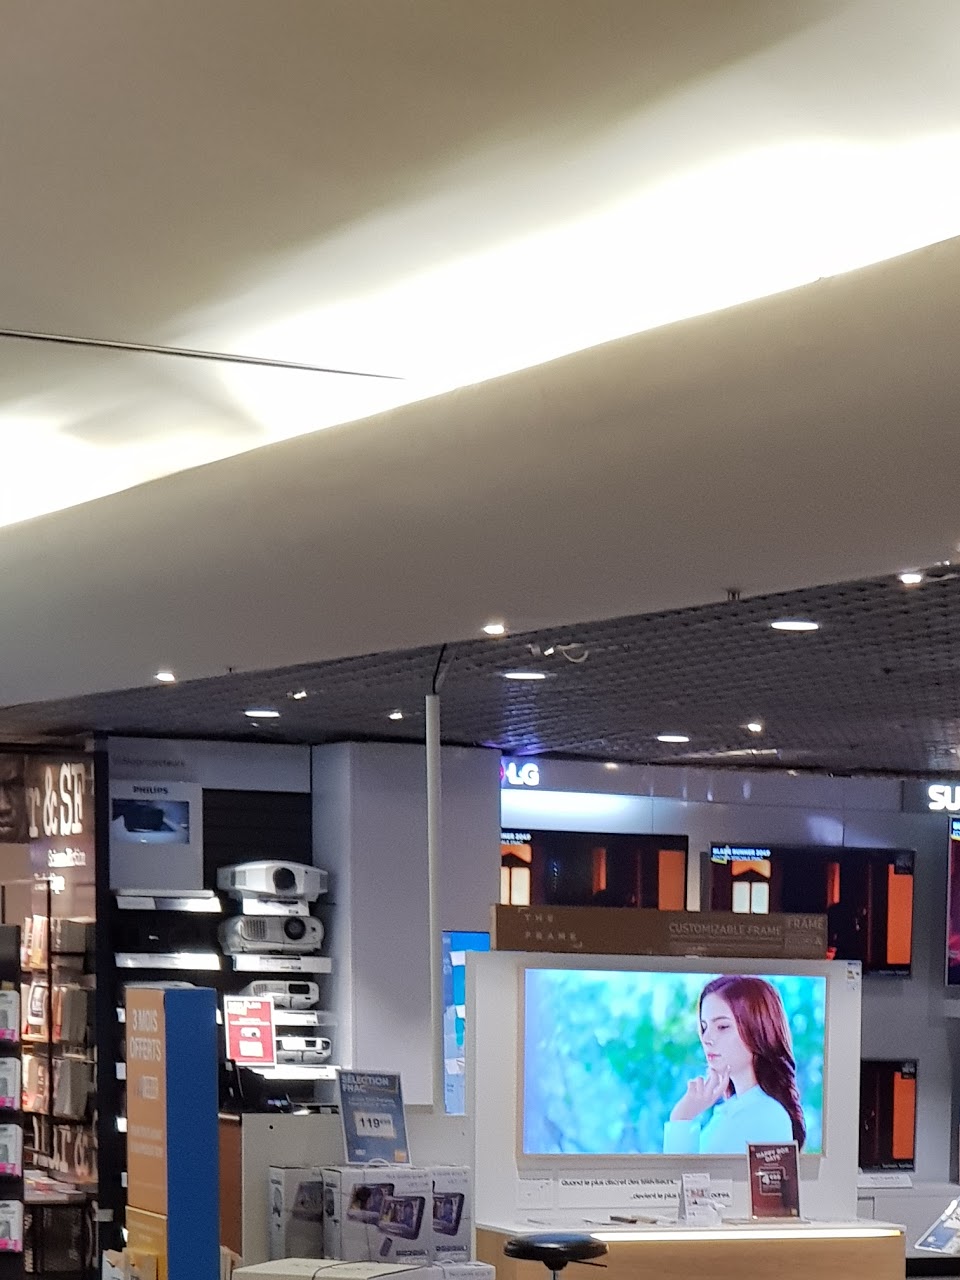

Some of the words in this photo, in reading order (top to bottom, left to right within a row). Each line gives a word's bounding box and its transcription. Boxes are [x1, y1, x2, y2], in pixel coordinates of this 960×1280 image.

[506, 762, 540, 786] LG
[132, 785, 169, 795] PHILIPS
[668, 922, 746, 936] CUSTOMIZABLE
[129, 1036, 162, 1062] OFFERTS
